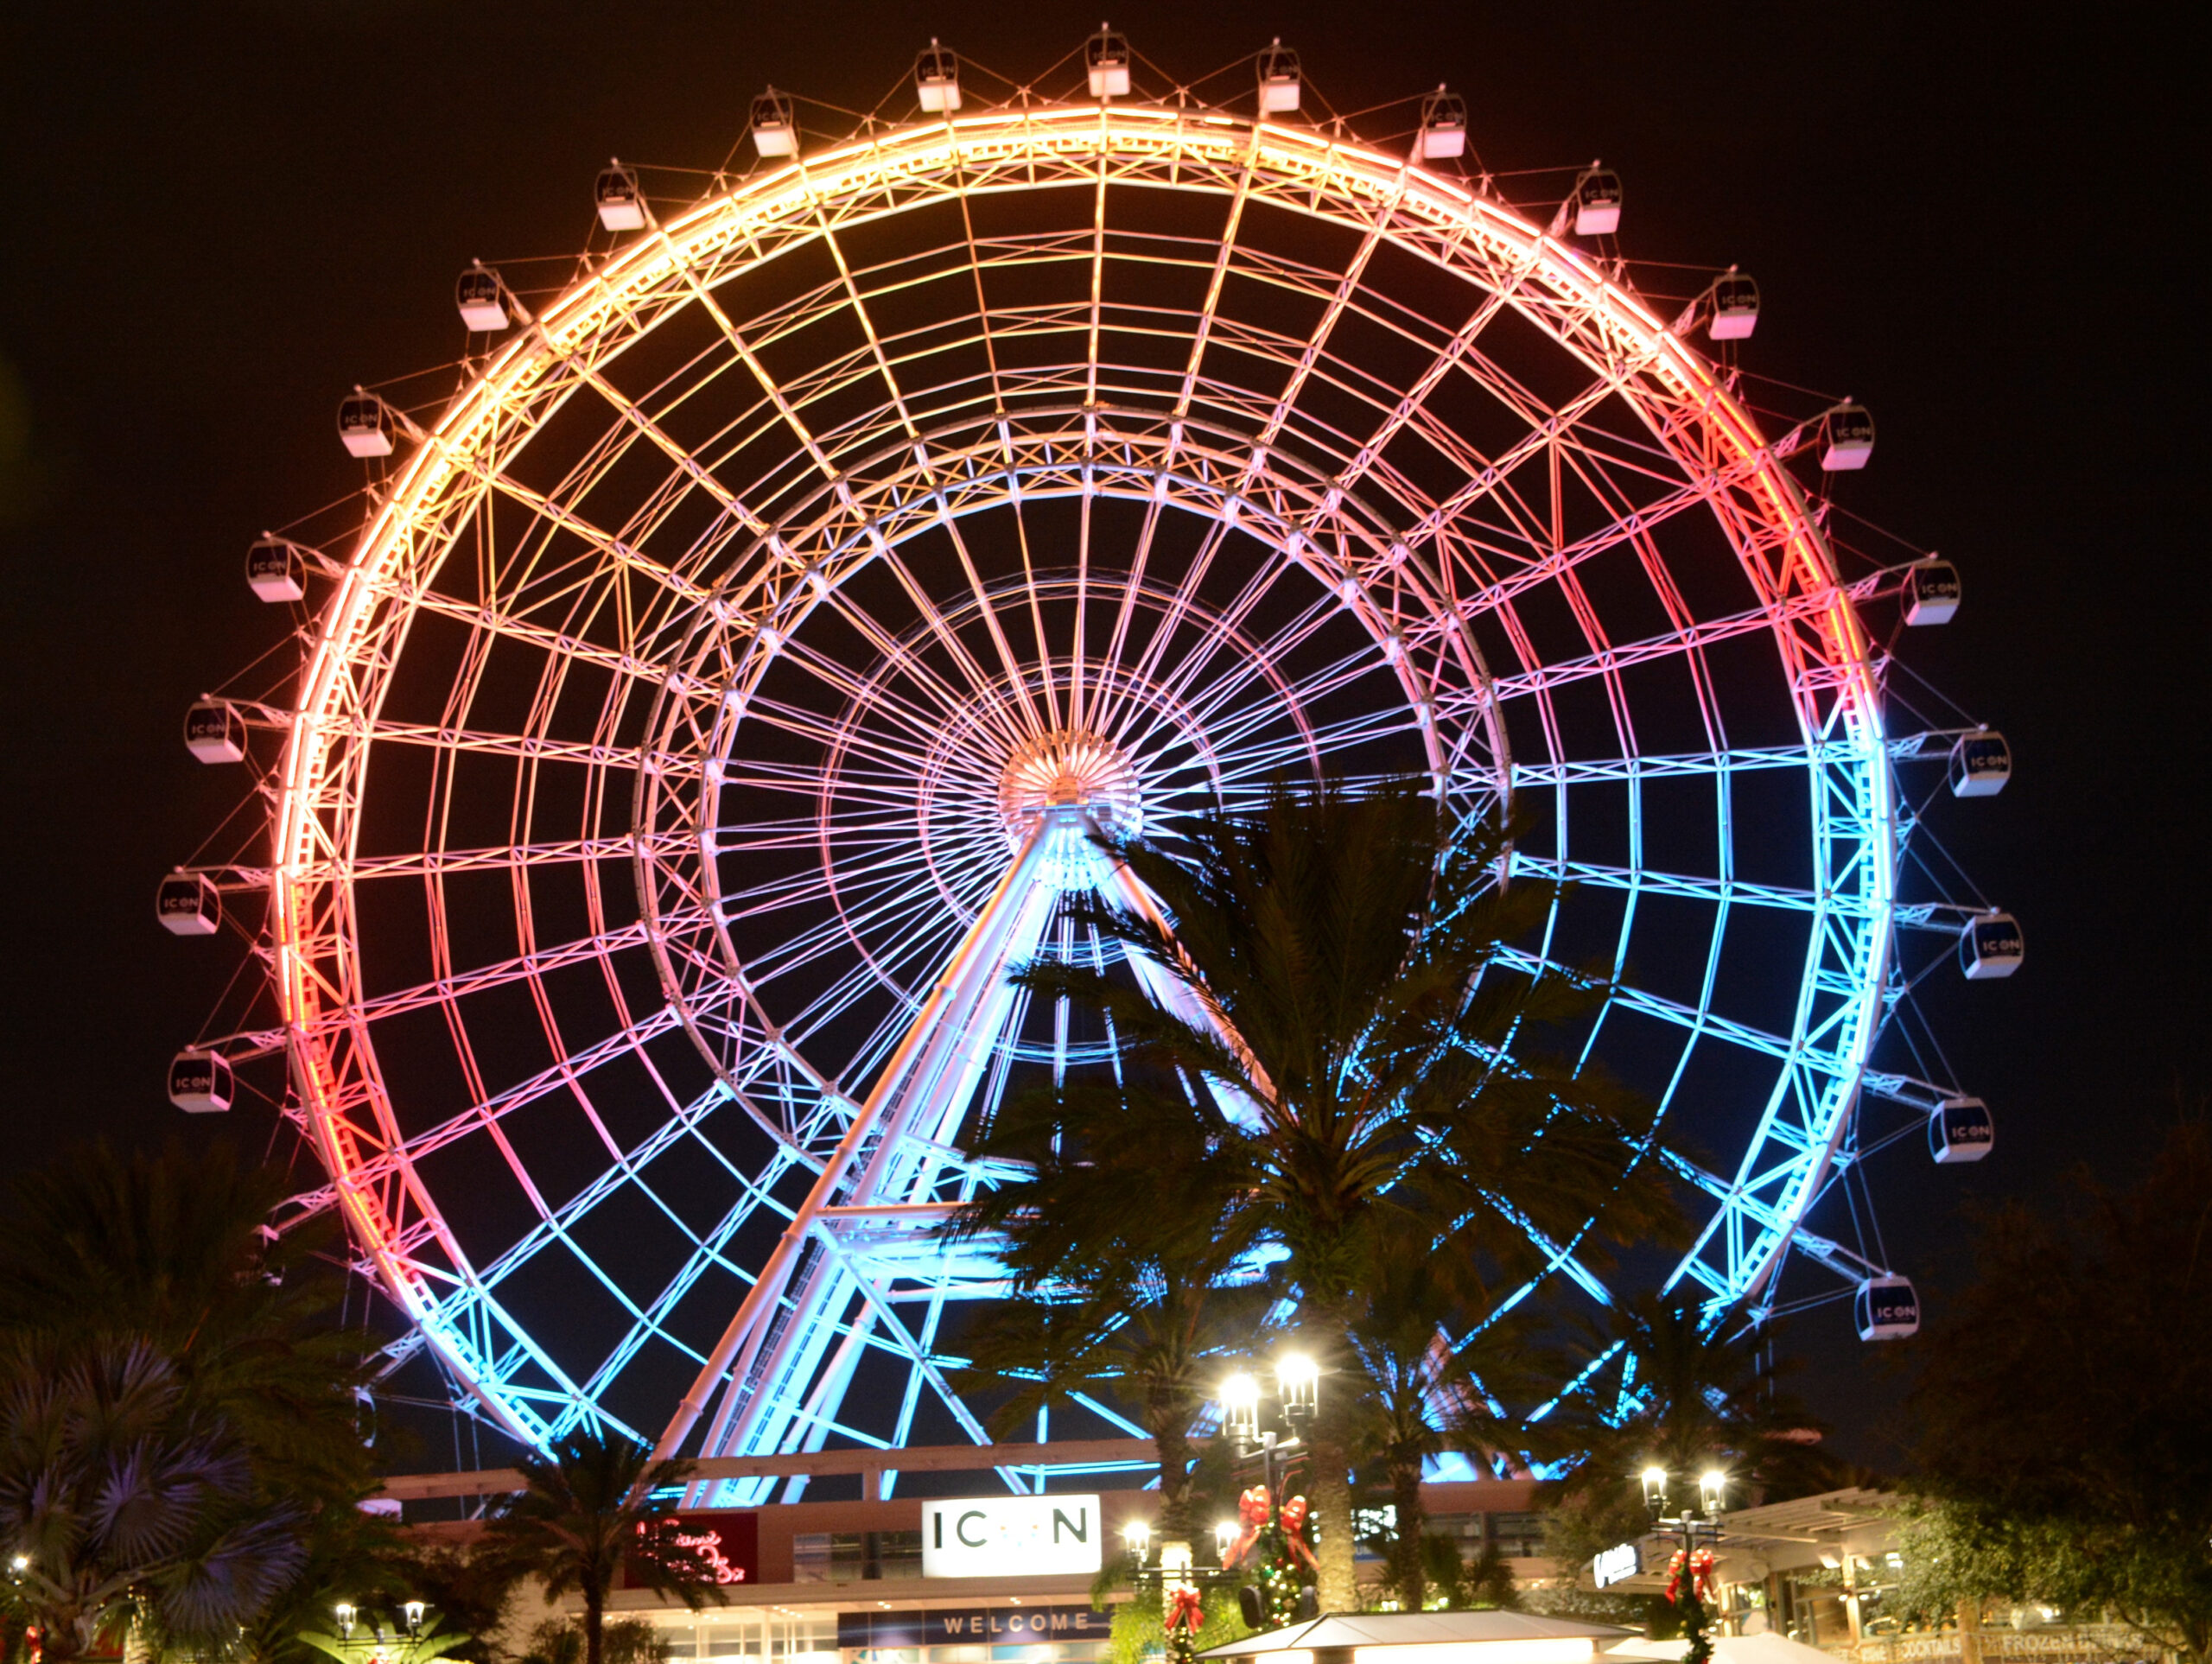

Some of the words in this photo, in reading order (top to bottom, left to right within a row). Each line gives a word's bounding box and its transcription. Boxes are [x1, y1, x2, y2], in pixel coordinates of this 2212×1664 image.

[1266, 65, 1299, 75] CON
[1722, 295, 1755, 304] ICON
[345, 414, 377, 423] ICON
[1837, 427, 1870, 437] ICON
[253, 561, 286, 572] ICON
[1922, 582, 1957, 594] ICON
[191, 724, 225, 734] ICON
[1971, 756, 2005, 766] ICON
[163, 898, 198, 908] ICON
[1982, 939, 2019, 951] ICON
[176, 1077, 210, 1088] ICON
[1952, 1125, 1989, 1137] ICON
[1877, 1305, 1915, 1318] ICON
[934, 1507, 1087, 1549] ICN
[944, 1613, 1089, 1634] WELCOME
